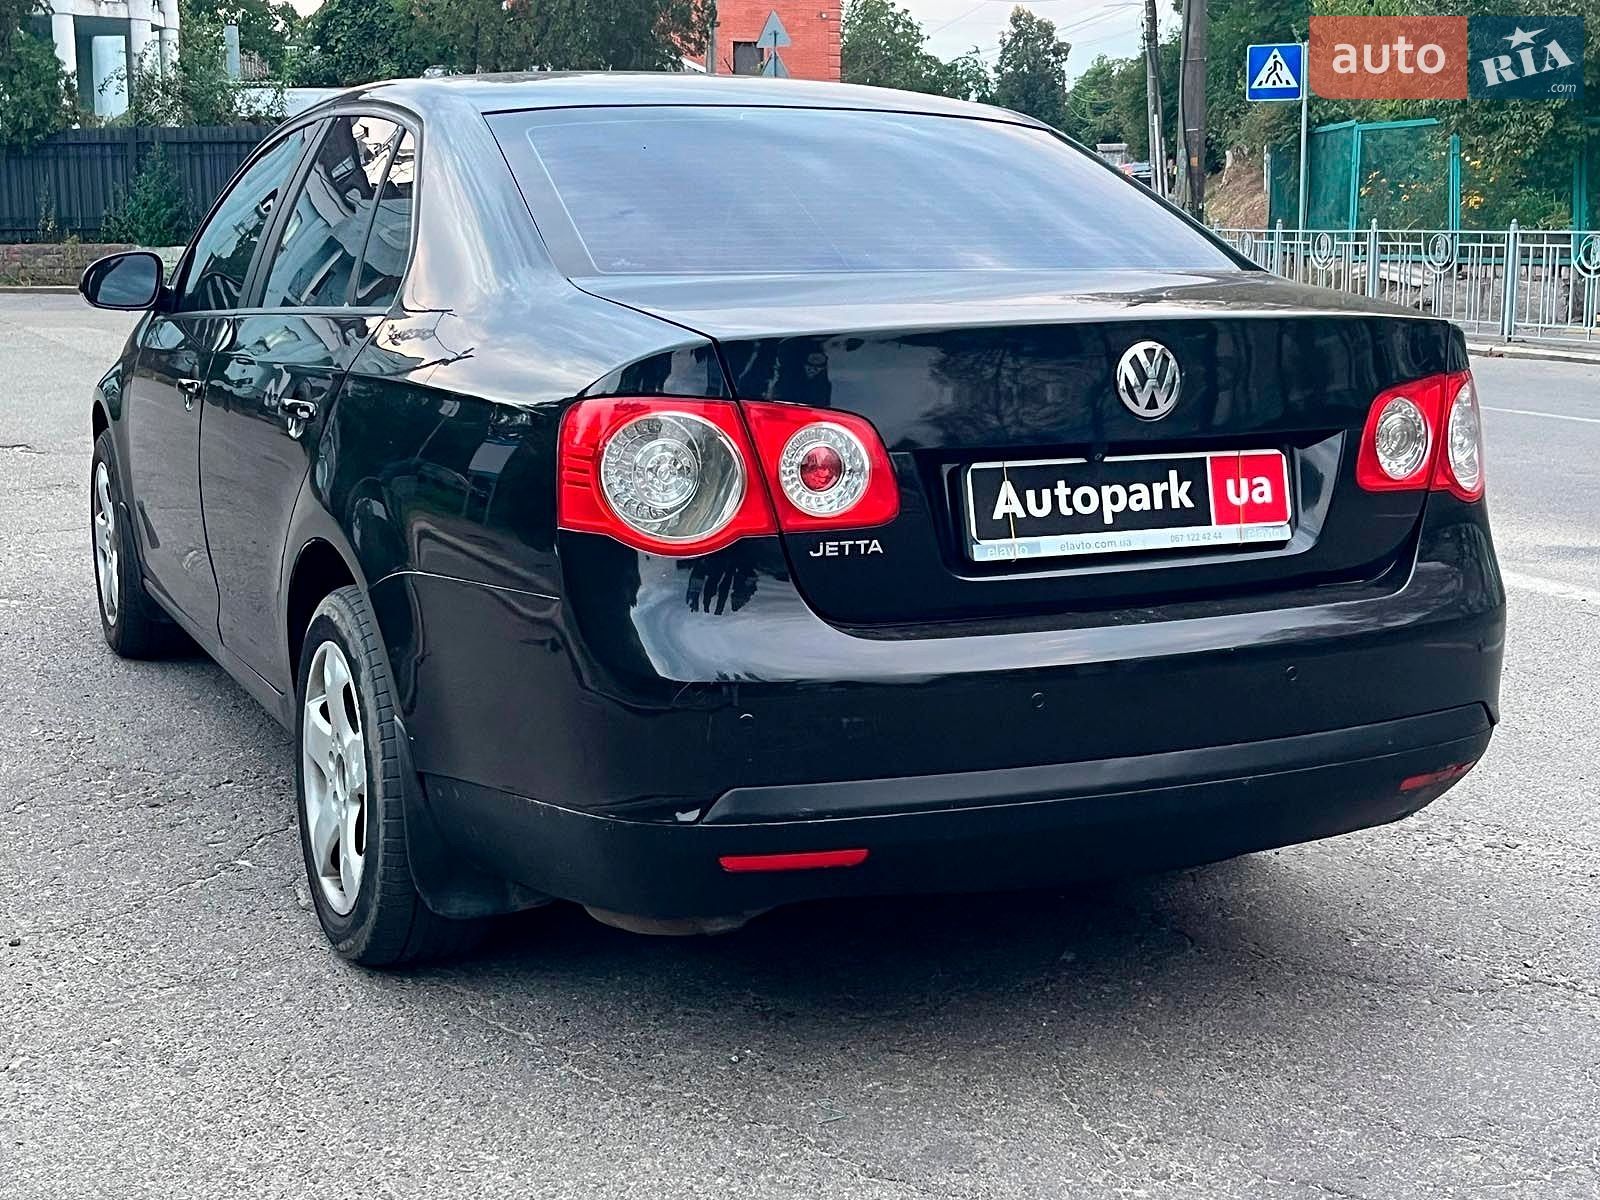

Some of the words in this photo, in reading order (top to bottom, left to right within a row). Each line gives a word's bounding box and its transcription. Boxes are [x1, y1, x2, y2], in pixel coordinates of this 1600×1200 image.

[992, 469, 1195, 525] Autopark
[1226, 475, 1273, 506] ua
[809, 539, 884, 557] JETTA
